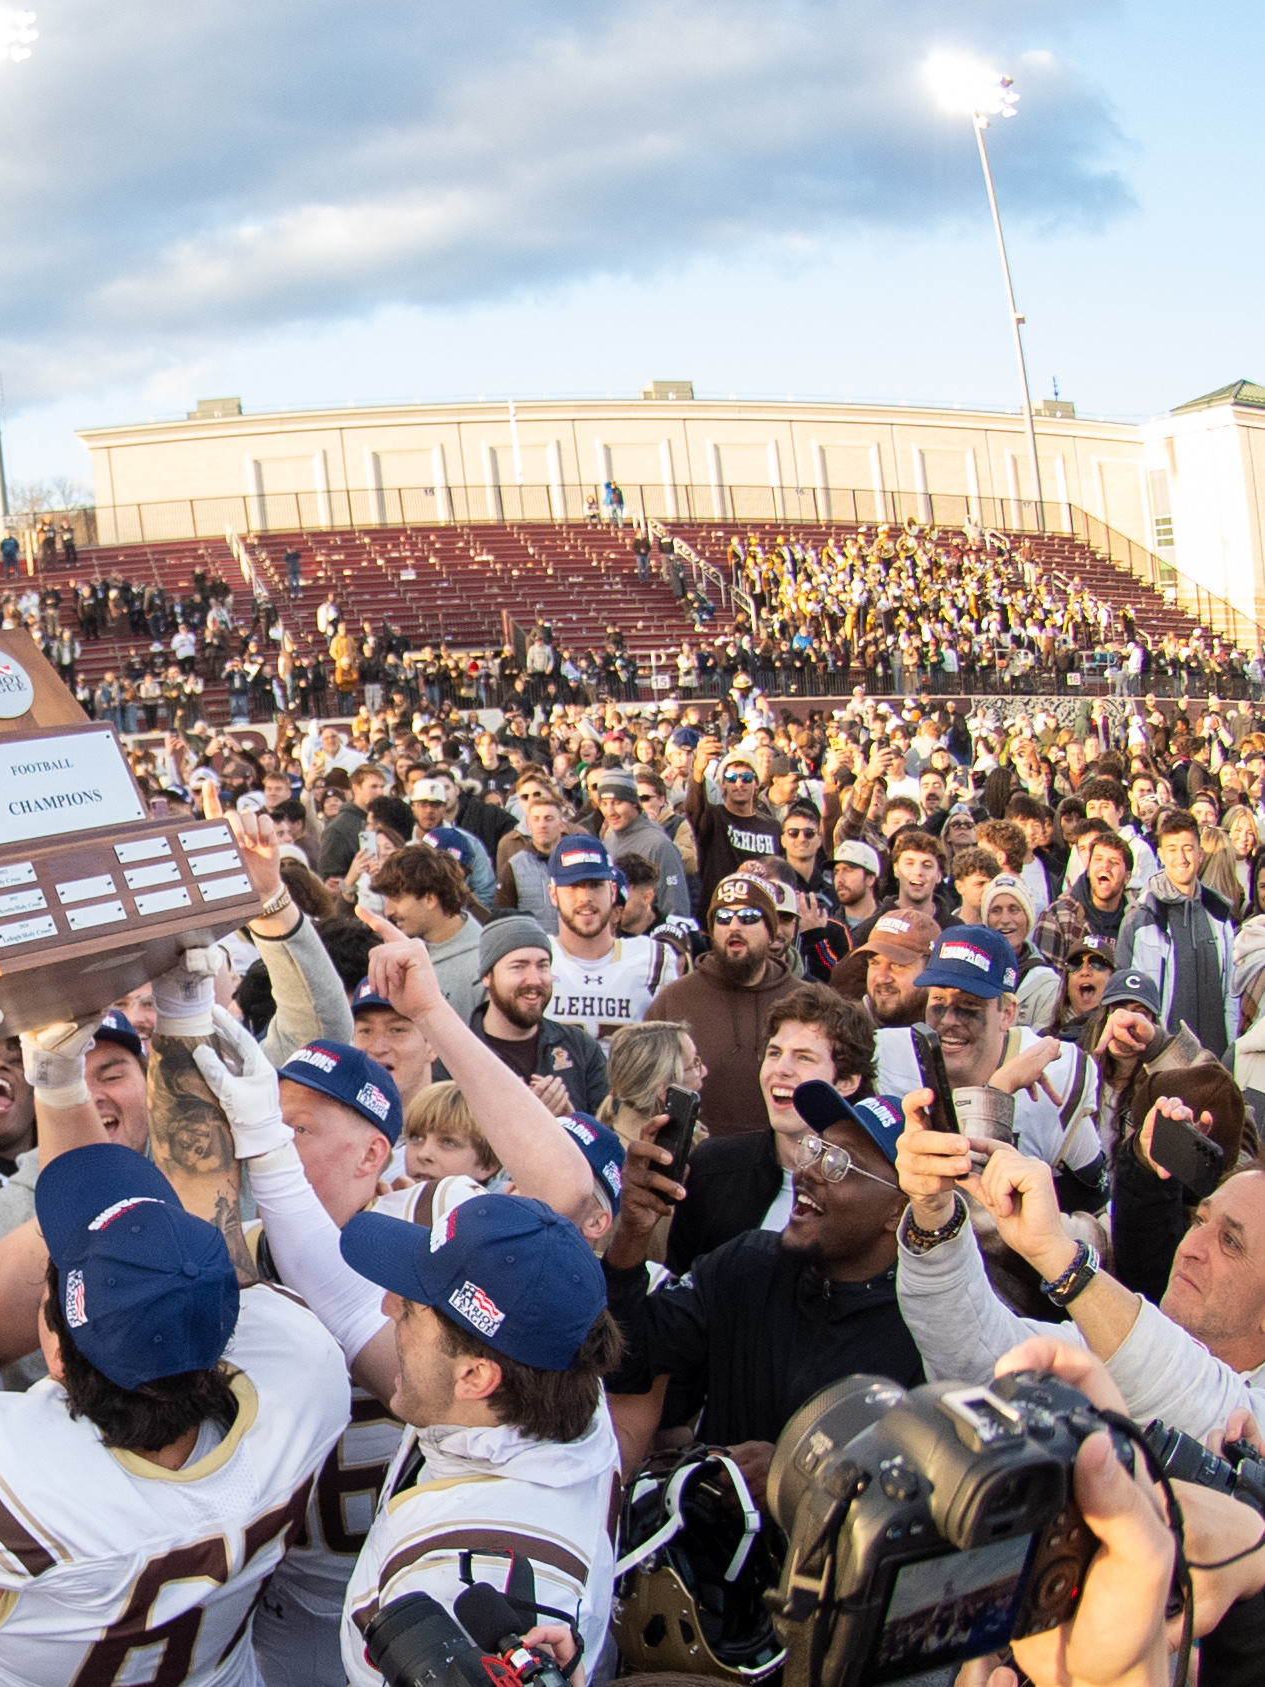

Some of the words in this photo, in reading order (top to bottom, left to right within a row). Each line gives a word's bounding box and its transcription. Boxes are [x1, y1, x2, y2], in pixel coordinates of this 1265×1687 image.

[10, 758, 74, 776] FOOTBALL
[8, 789, 103, 816] CHAMPIONS
[727, 824, 775, 855] LEHIGH
[717, 881, 748, 902] 150
[1125, 975, 1141, 989] C
[553, 996, 631, 1018] LEHIGH
[451, 1296, 495, 1335] LEAGUE
[457, 1291, 500, 1329] PATRIOT
